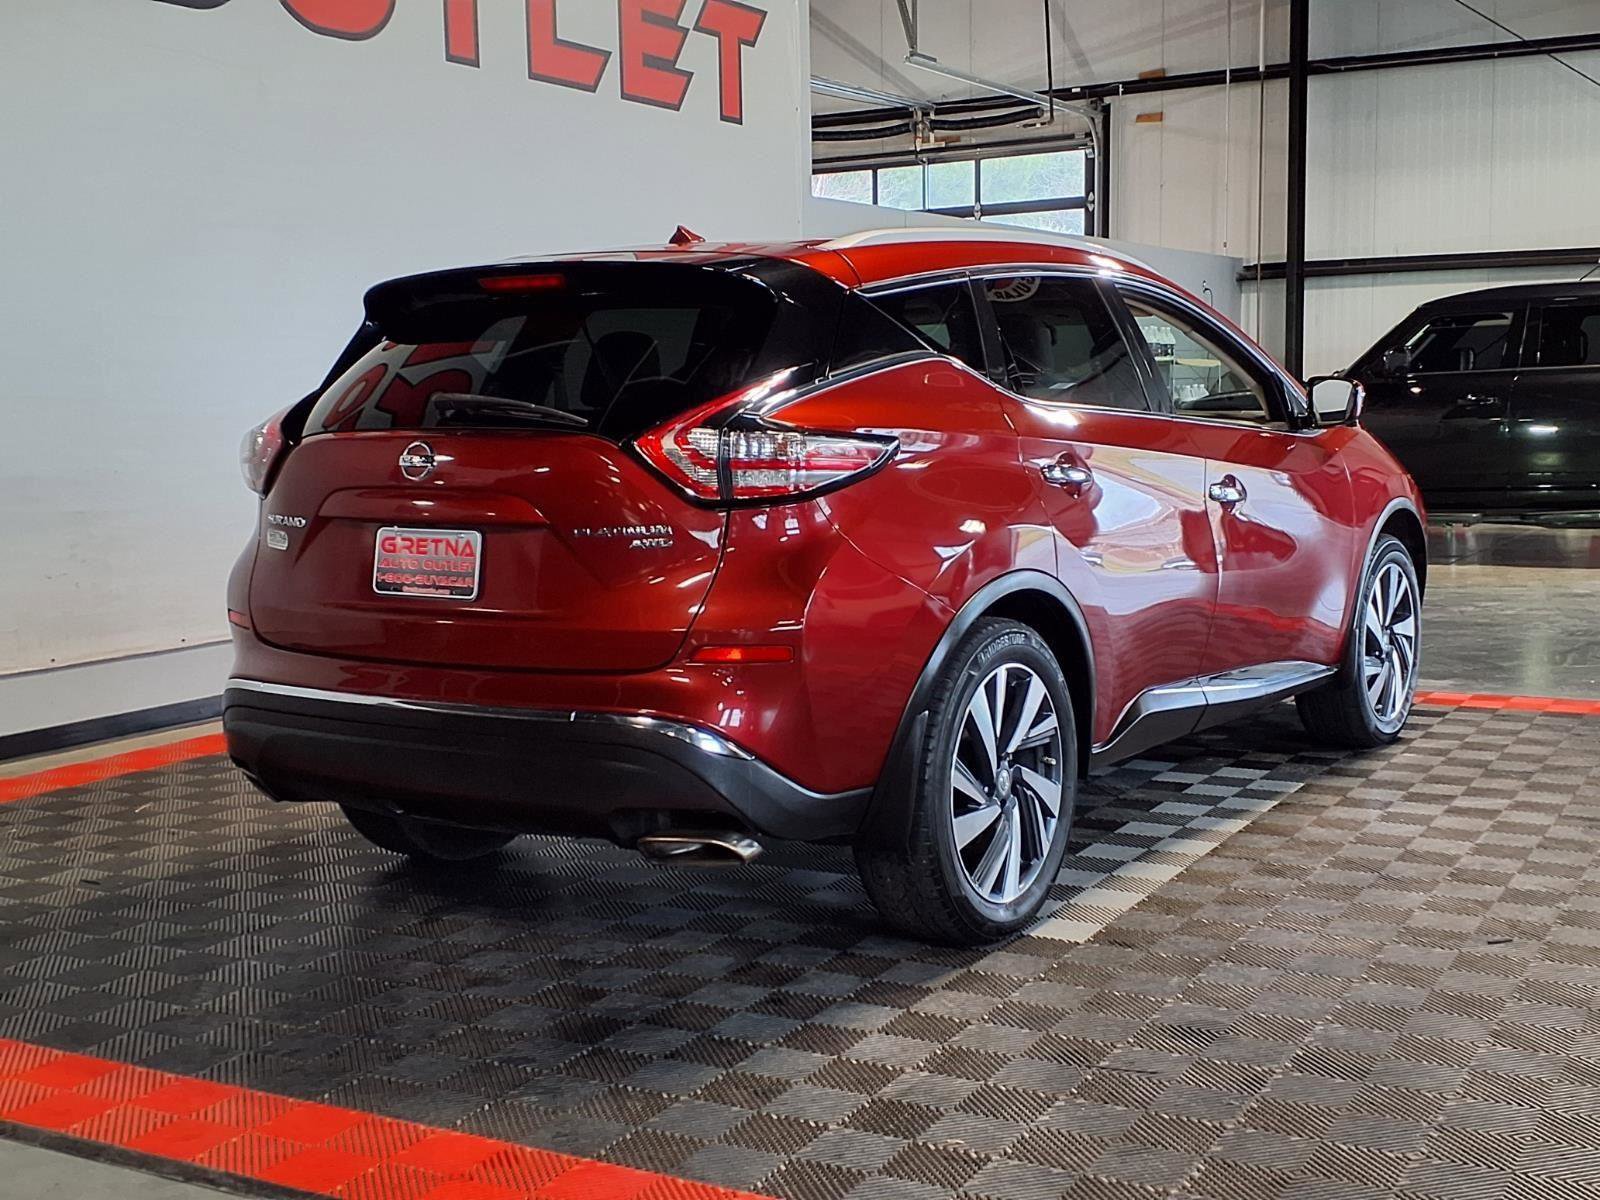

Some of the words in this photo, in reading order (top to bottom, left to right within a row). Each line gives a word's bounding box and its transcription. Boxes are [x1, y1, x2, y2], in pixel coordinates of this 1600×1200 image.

[573, 525, 673, 537] PLATINUM
[381, 536, 476, 558] GRETNA
[380, 558, 418, 570] AUTO
[423, 559, 474, 572] OUTLET
